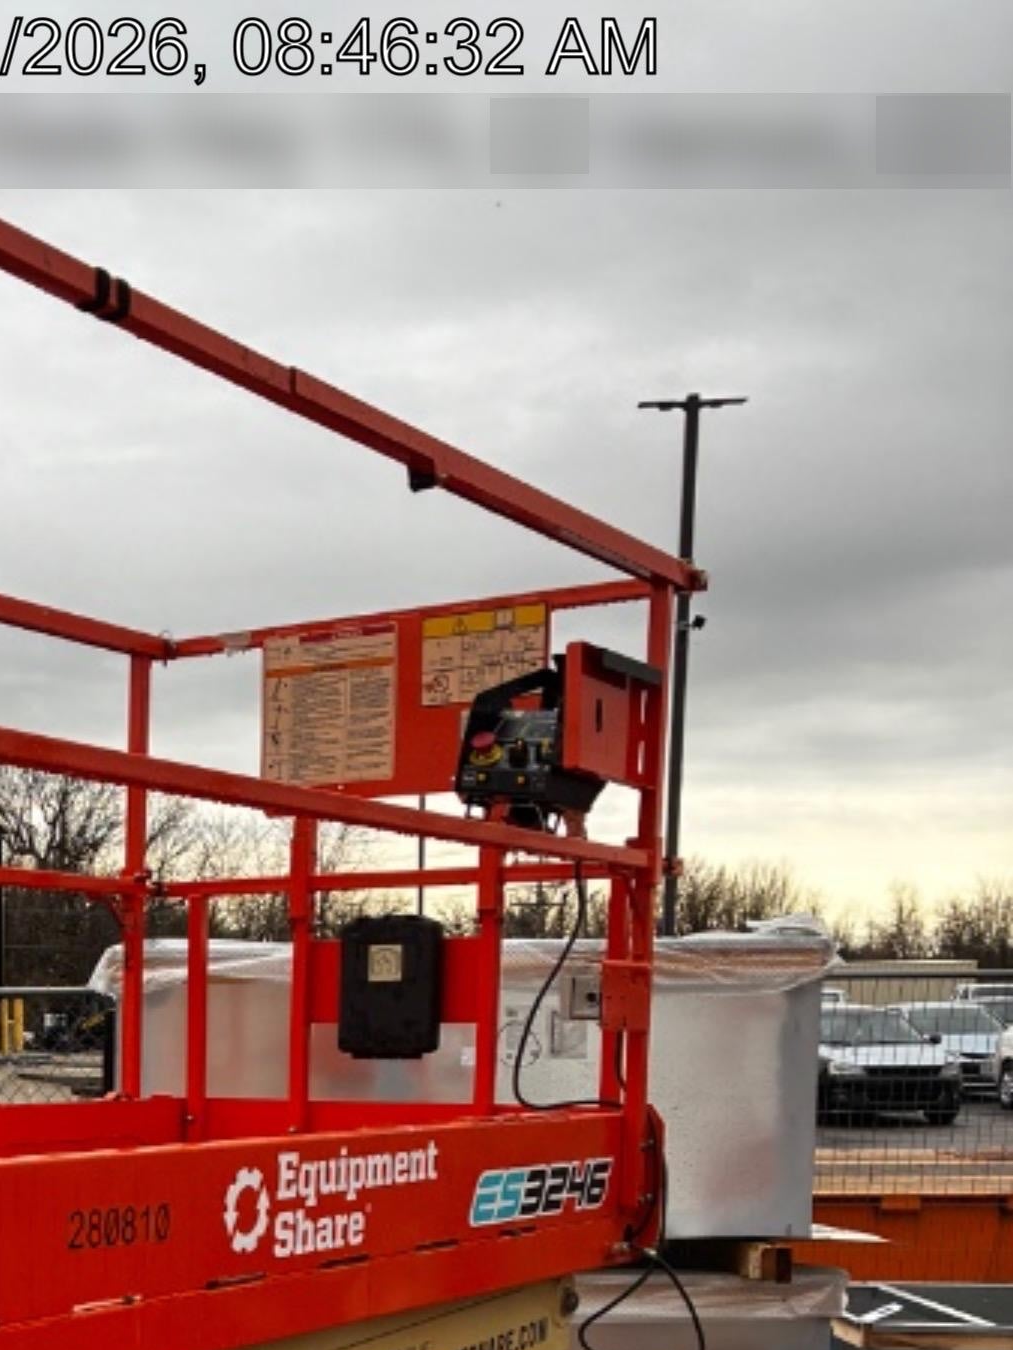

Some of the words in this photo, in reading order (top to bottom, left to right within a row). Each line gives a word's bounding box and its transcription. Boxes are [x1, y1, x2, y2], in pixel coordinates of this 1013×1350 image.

[275, 1140, 439, 1206] Equipment
[469, 1157, 614, 1228] ES3246
[67, 1202, 172, 1251] 280810
[274, 1211, 366, 1258] Share
